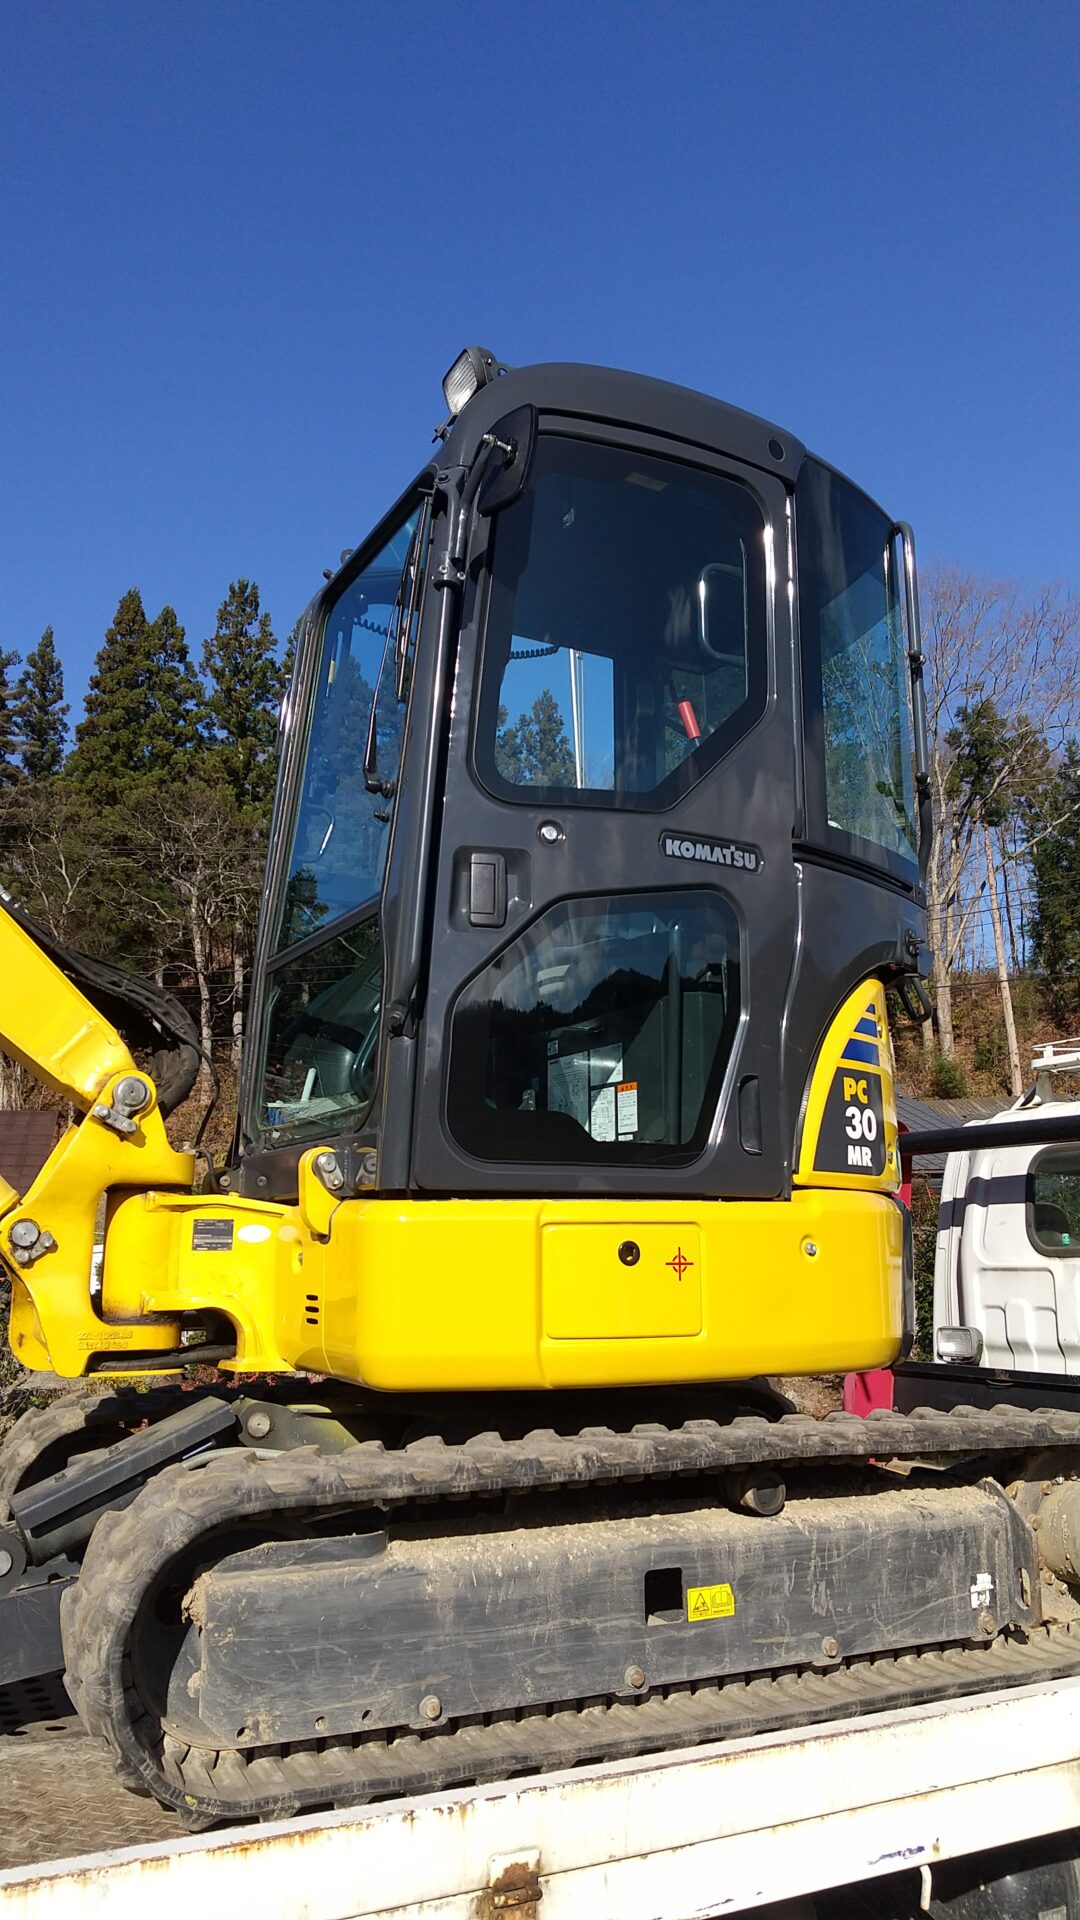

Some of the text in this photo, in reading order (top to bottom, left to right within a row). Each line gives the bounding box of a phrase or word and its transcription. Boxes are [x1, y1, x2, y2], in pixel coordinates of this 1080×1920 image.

[666, 838, 756, 869] KOMATSU
[843, 1076, 868, 1104] PC
[845, 1106, 877, 1141] 30
[847, 1145, 872, 1168] MR
